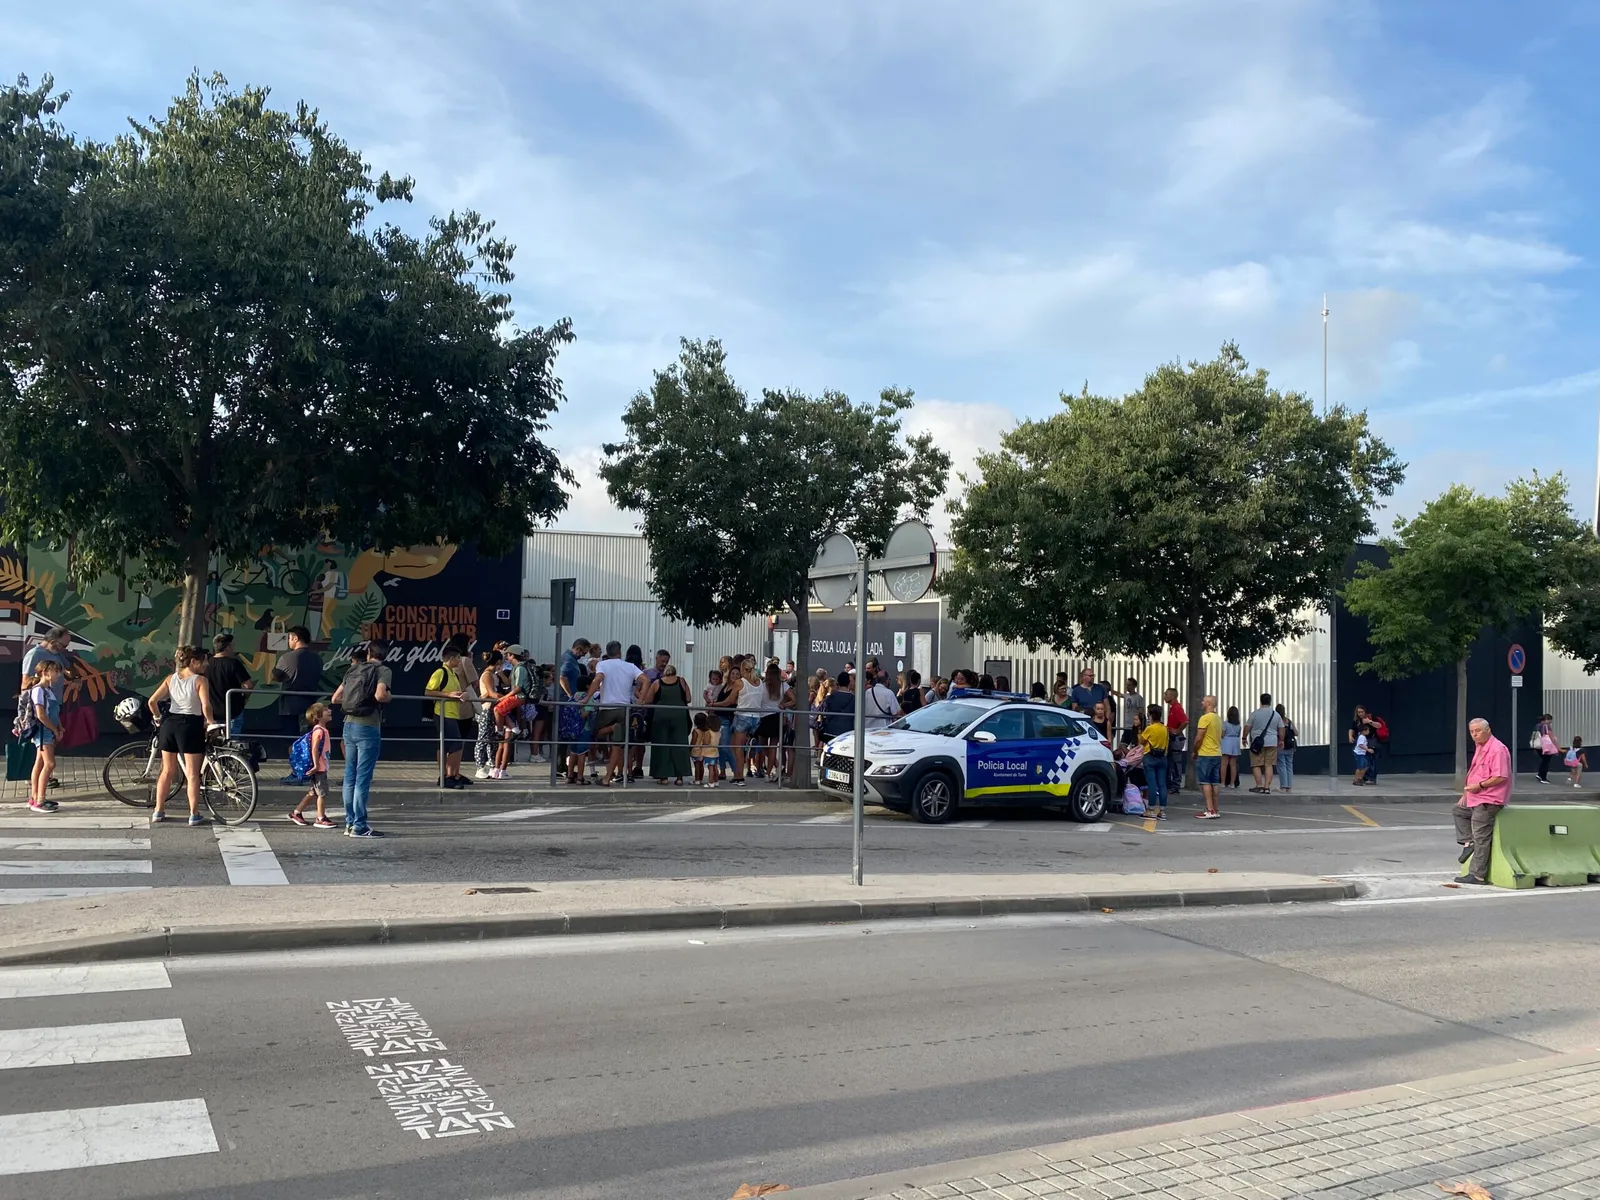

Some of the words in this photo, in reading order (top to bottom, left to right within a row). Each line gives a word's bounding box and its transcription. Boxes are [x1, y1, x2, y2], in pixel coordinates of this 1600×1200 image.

[385, 604, 477, 625] CONSTRUÏM
[386, 622, 437, 642] FUTUR
[812, 640, 834, 653] ESCOLA
[836, 641, 851, 654] LOLA
[853, 642, 884, 656] ALADA
[978, 760, 1004, 770] Policia
[1006, 761, 1028, 770] Local
[408, 1090, 464, 1099] TIANA
